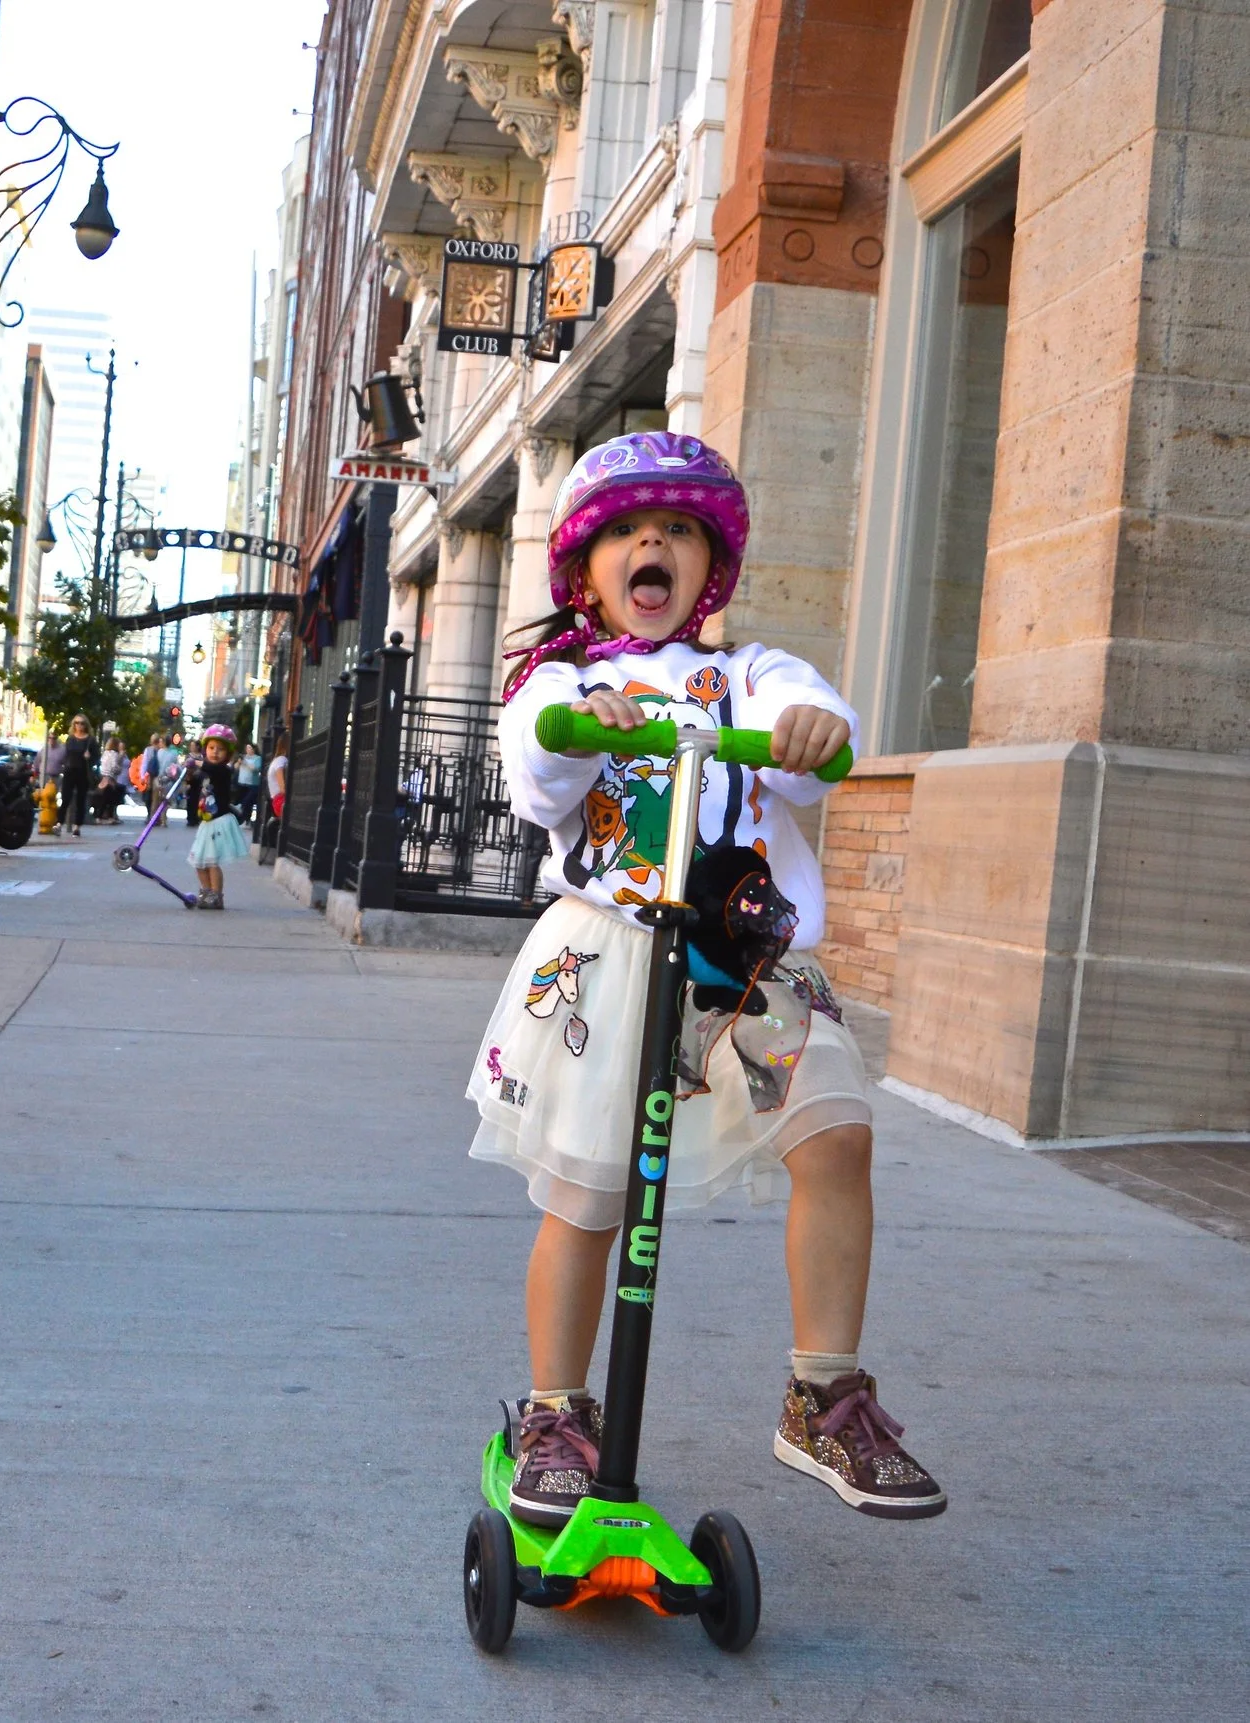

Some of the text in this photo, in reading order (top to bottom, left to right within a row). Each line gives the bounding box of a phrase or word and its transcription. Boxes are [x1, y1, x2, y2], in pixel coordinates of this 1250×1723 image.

[445, 239, 519, 260] OXFORD
[452, 334, 499, 353] CLUB
[339, 461, 429, 483] AMANTE
[114, 530, 298, 565] OFORD
[628, 1090, 674, 1267] micro
